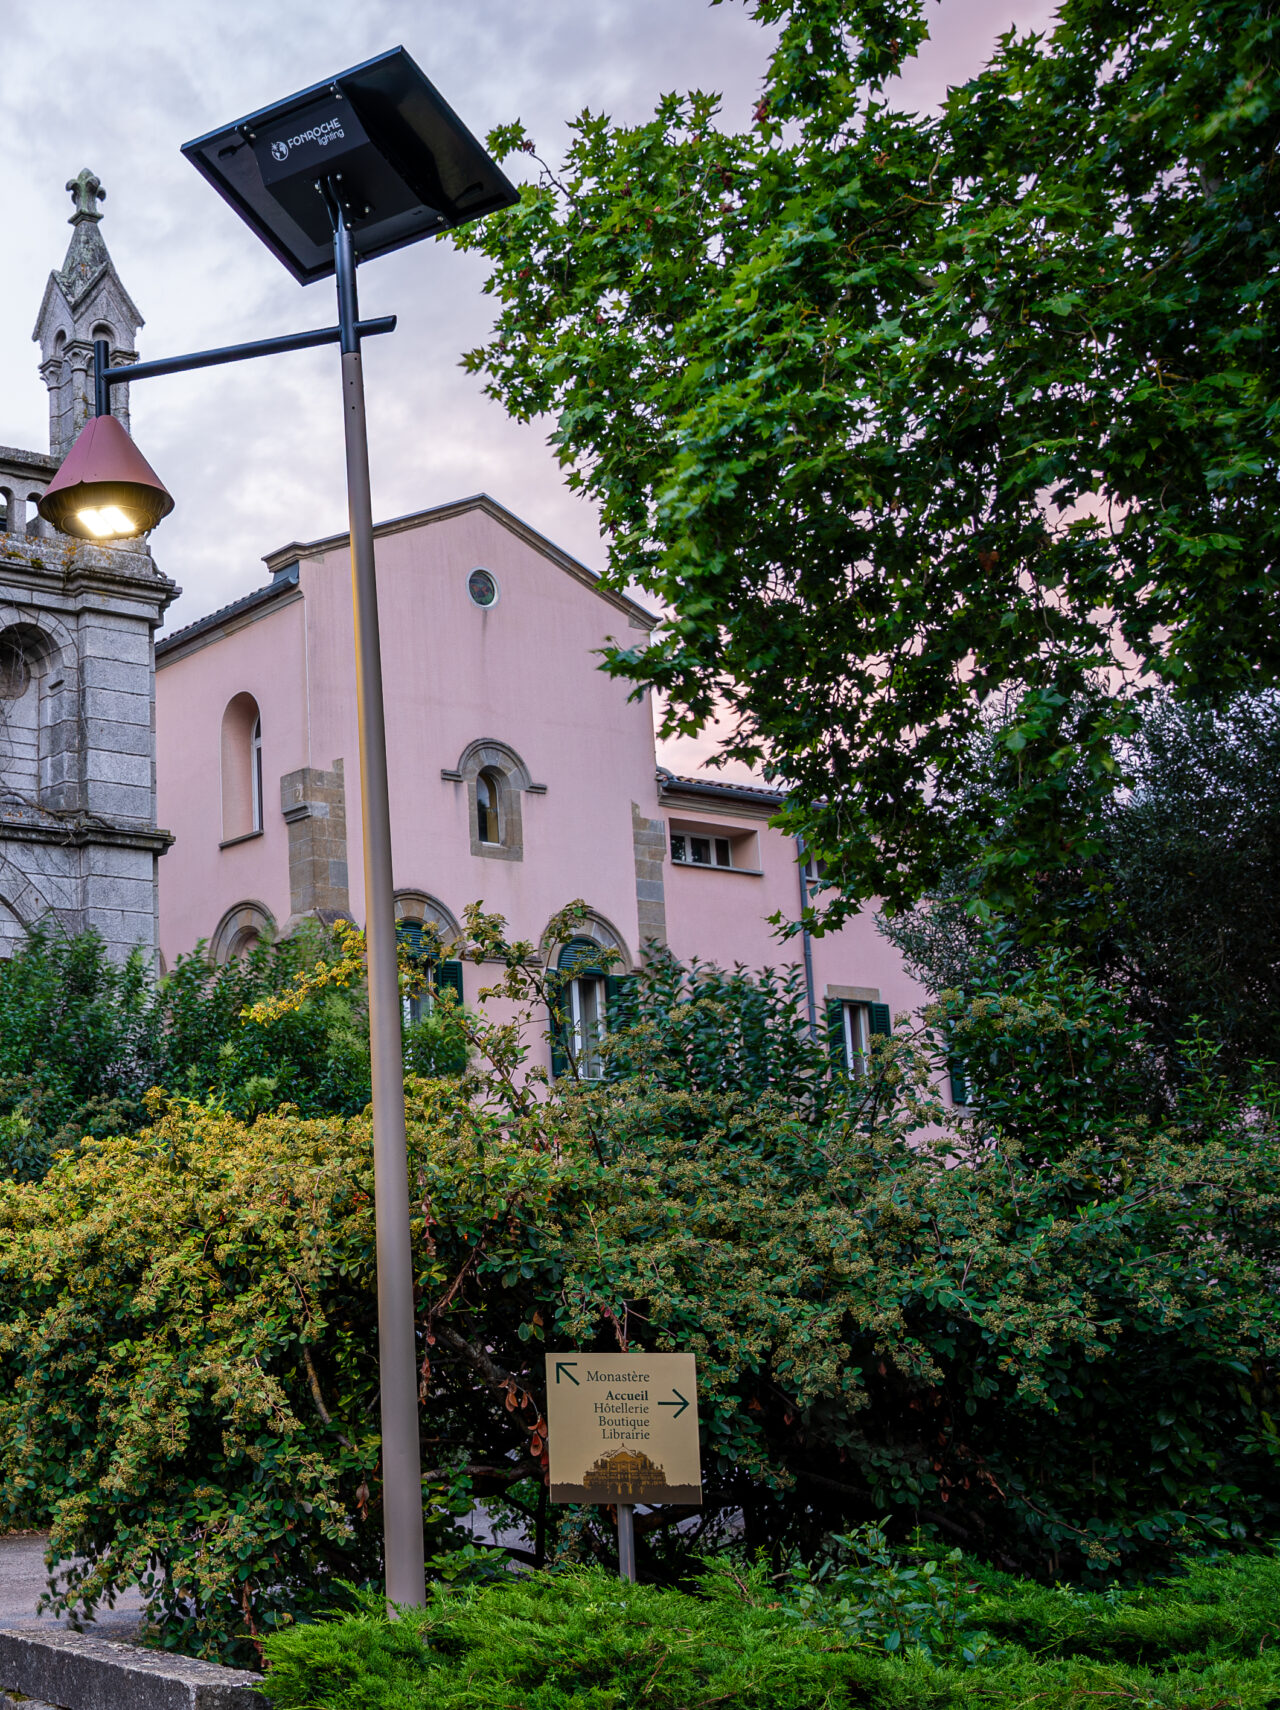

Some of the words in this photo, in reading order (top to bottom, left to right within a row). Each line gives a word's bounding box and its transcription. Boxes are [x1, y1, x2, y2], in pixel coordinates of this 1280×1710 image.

[287, 117, 341, 149] FONROCHE
[317, 128, 345, 146] lighting
[586, 1371, 650, 1382] Monastère
[605, 1390, 649, 1401] Accueil
[593, 1402, 650, 1414] Hôtellerie
[598, 1415, 650, 1430] Boutique
[602, 1429, 650, 1440] Librairie
